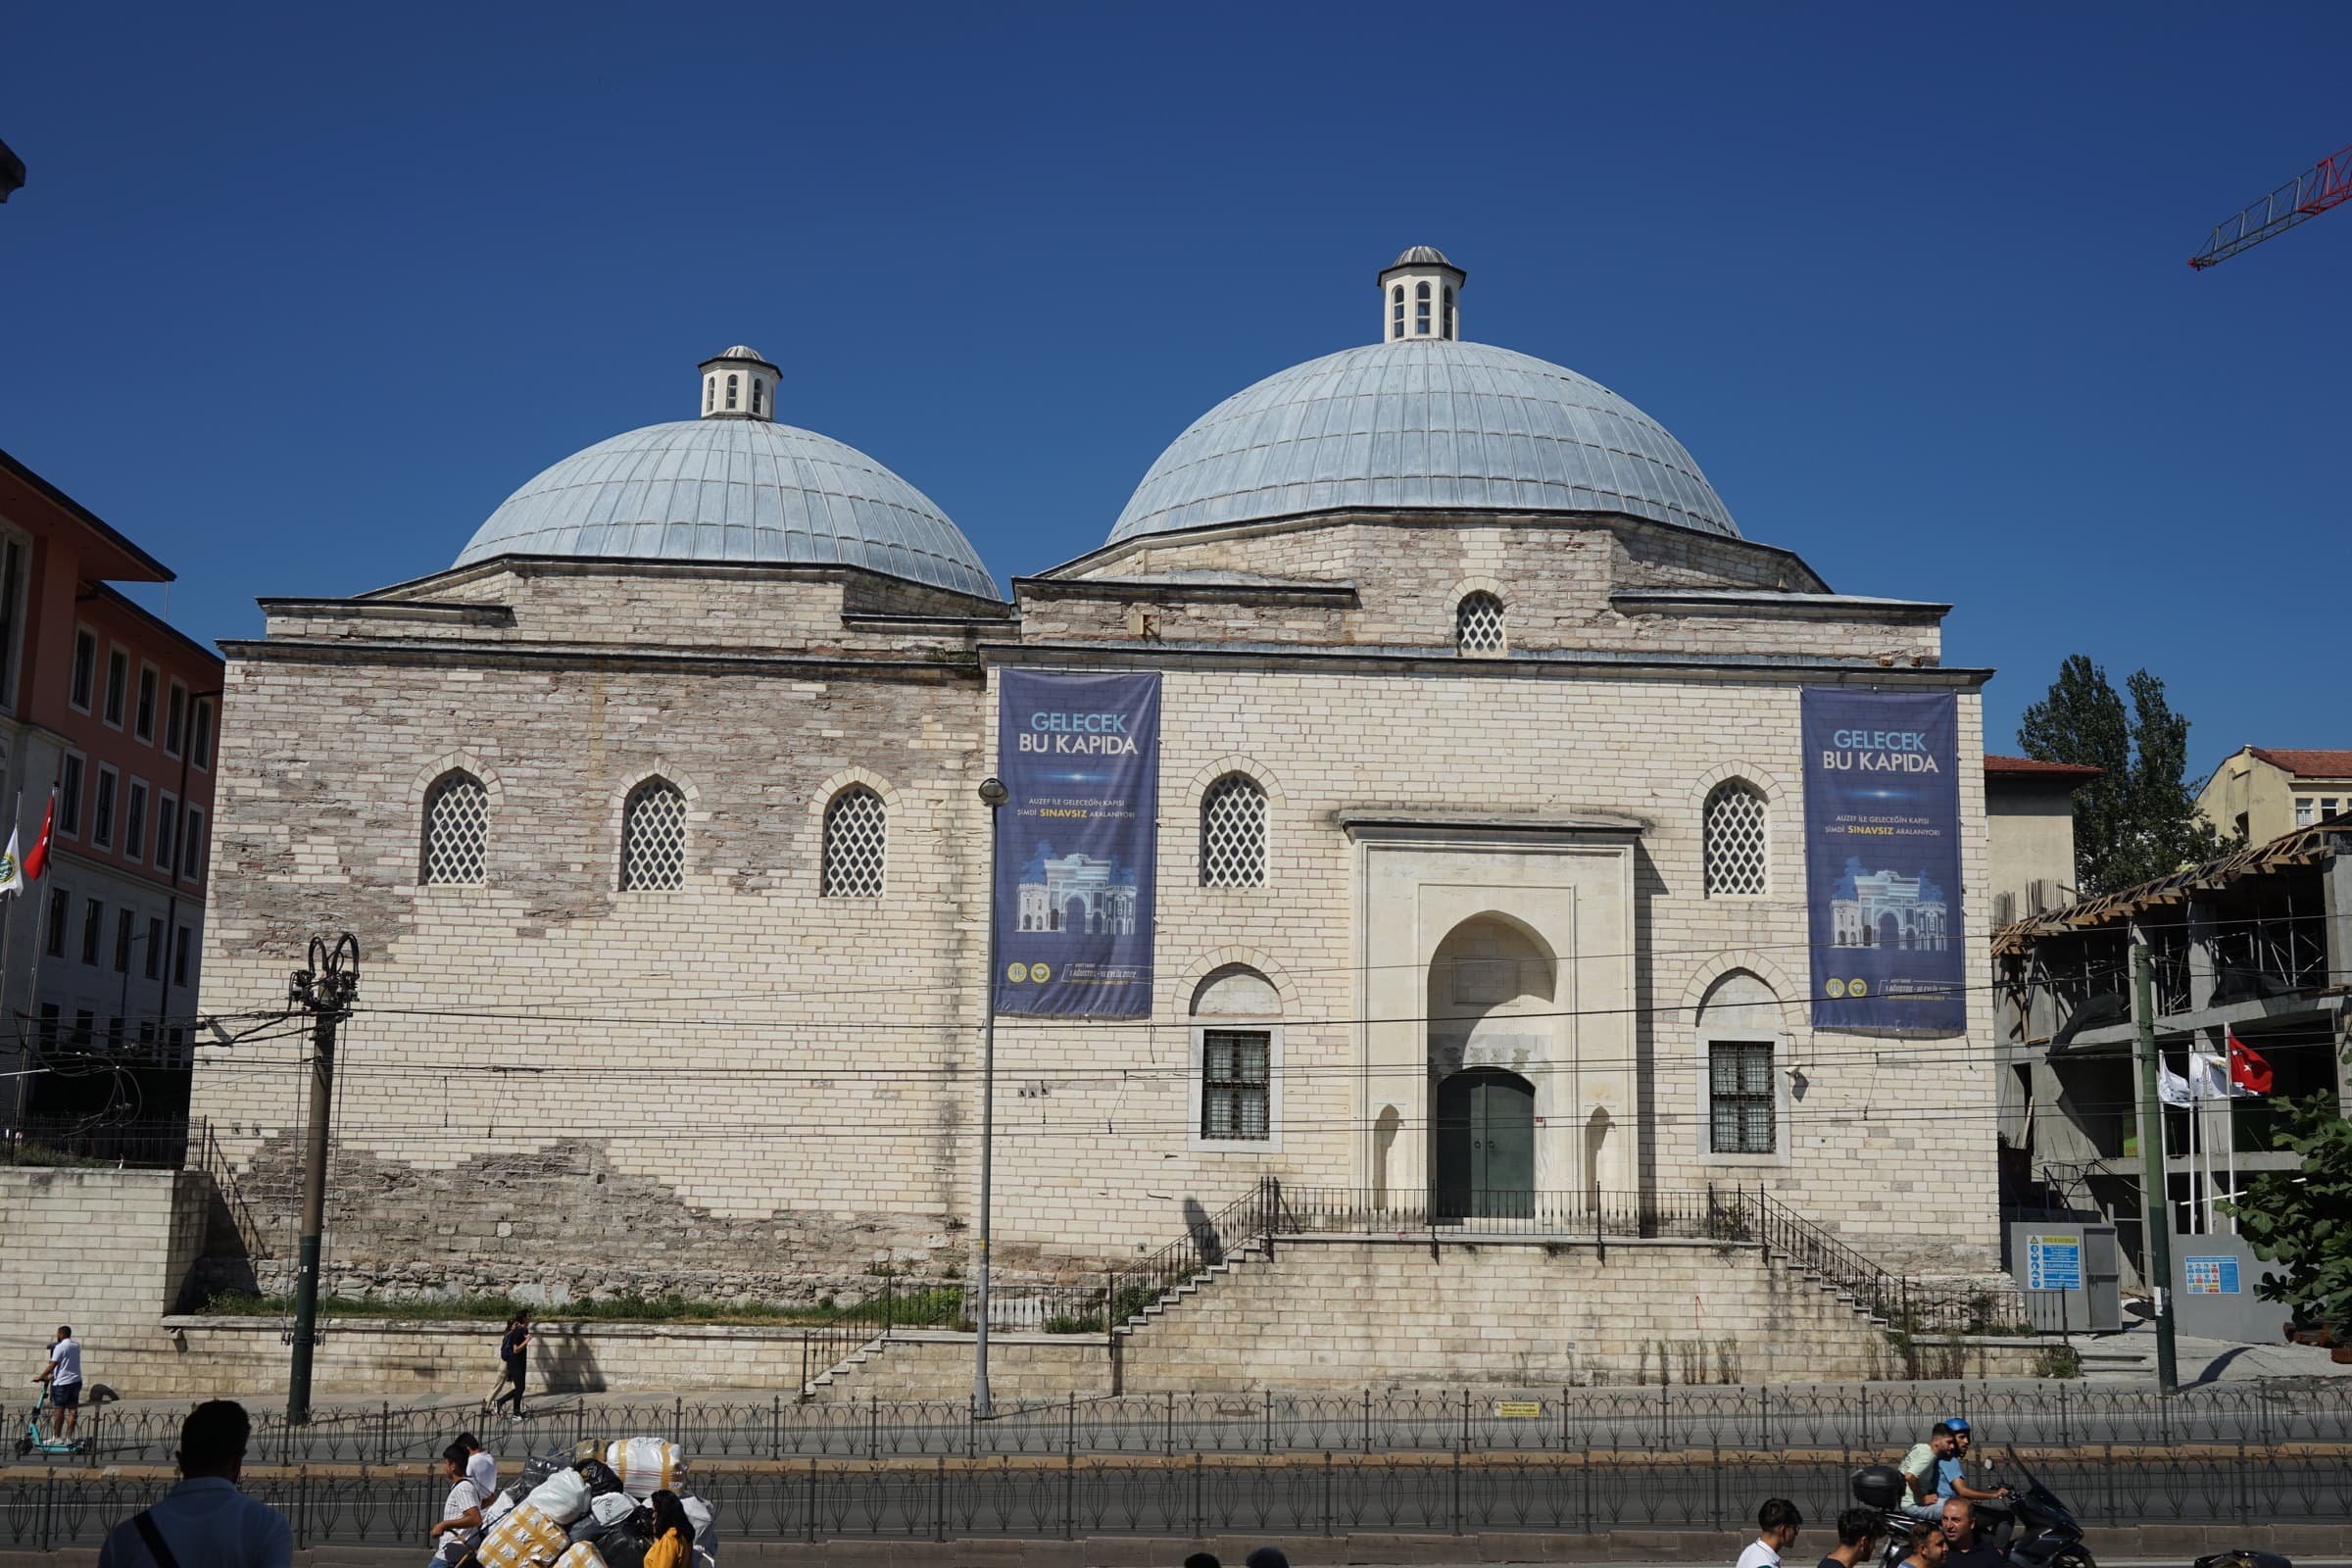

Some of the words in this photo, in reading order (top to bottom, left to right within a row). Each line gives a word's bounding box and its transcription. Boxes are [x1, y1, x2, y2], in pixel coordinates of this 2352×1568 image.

[1031, 711, 1128, 733] GELECEK
[1019, 734, 1049, 753] BU
[1055, 735, 1138, 755] KAPIDA
[1834, 729, 1928, 752] GELECEK
[1823, 751, 1852, 770] BU
[1859, 752, 1939, 773] KAPIDA
[1040, 808, 1088, 818] SINAVSIZ
[1869, 814, 1907, 824] GELECEĞİN
[1847, 825, 1894, 835] SINAVSIZ
